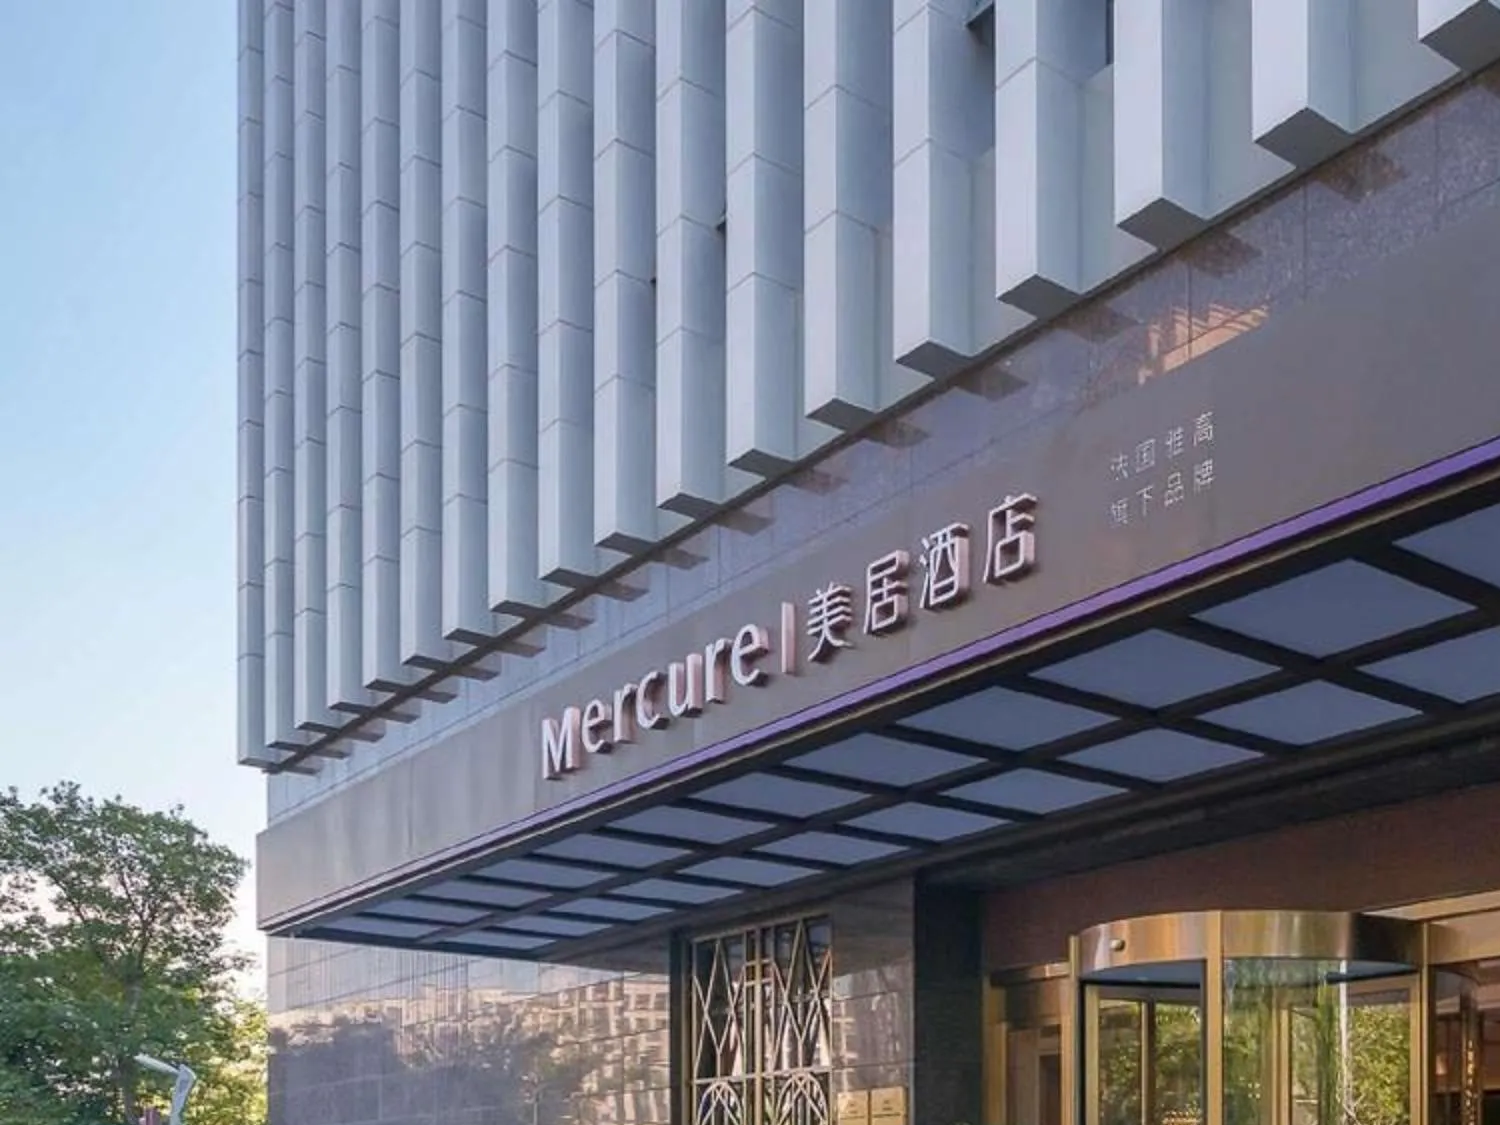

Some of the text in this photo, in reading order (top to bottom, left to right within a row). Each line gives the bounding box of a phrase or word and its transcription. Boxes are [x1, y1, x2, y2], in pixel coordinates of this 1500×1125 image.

[541, 493, 1038, 780] Mercure 美居酒店
